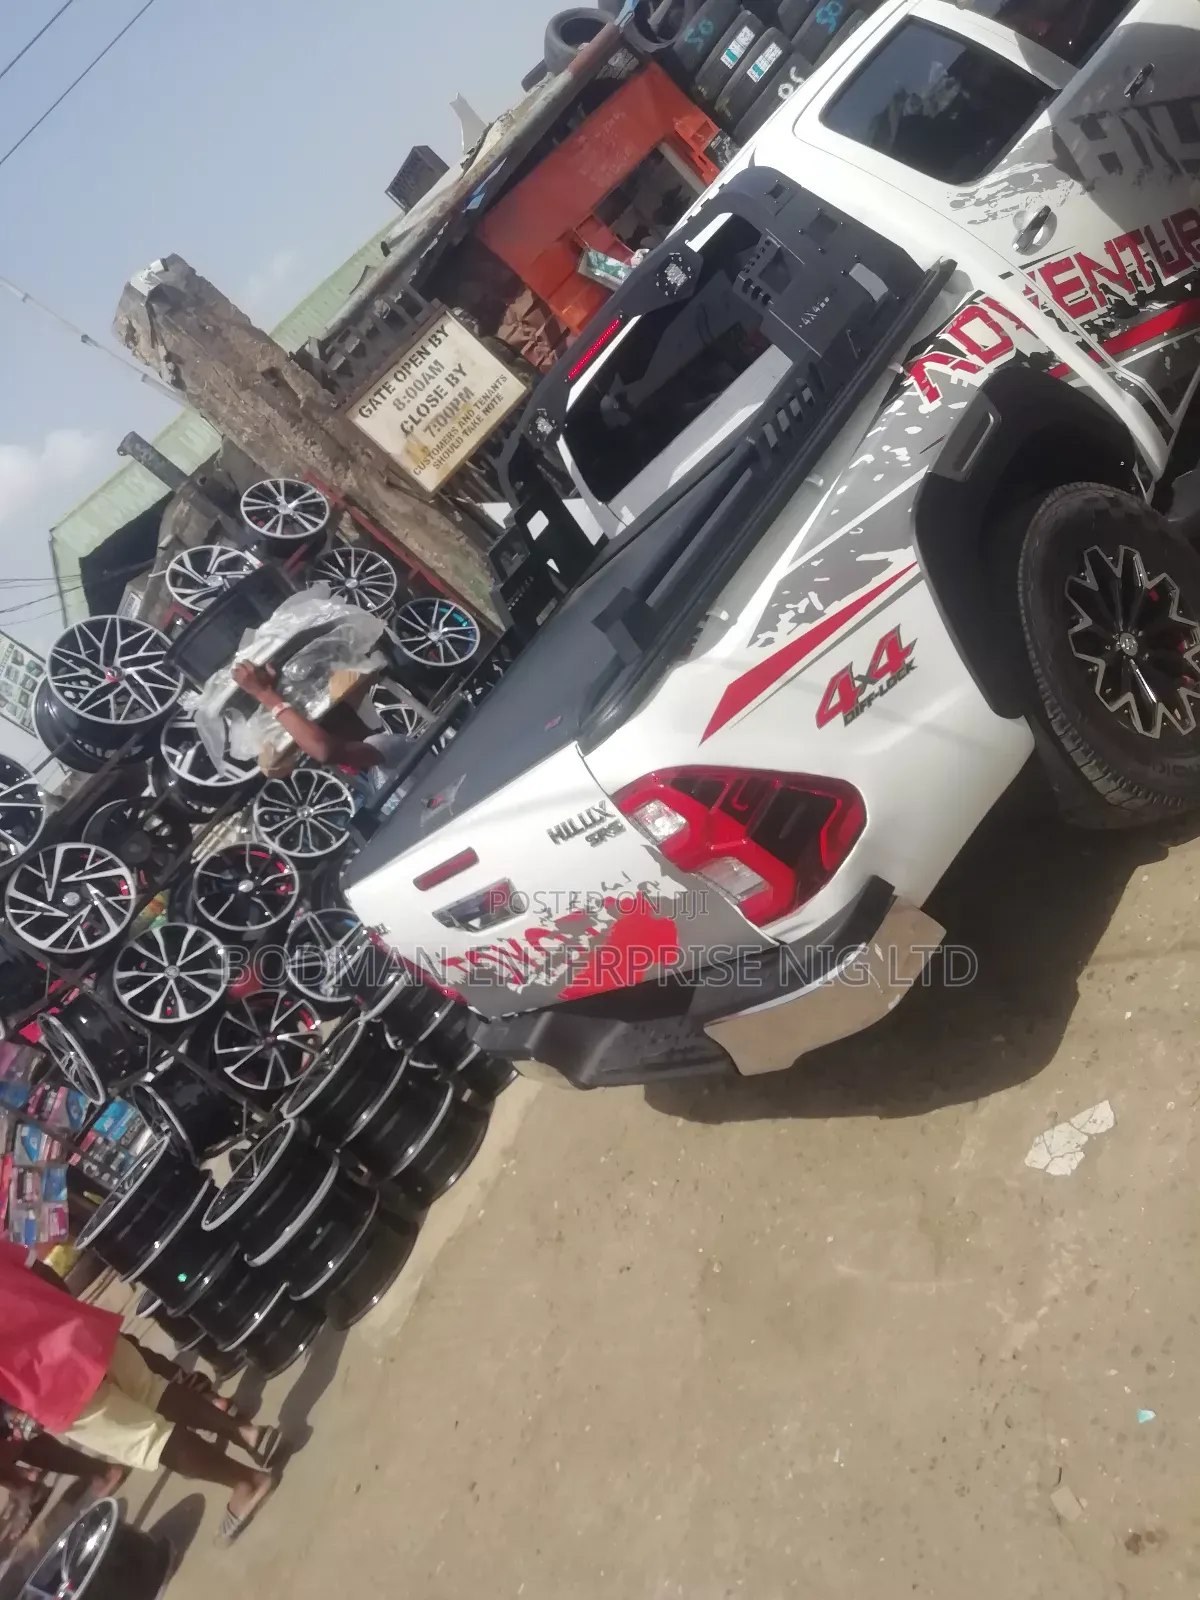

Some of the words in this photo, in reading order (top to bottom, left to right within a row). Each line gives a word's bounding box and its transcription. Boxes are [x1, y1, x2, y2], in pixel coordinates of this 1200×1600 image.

[358, 380, 397, 418] GATE
[393, 345, 432, 383] OPEN
[427, 324, 450, 349] BY
[392, 359, 446, 412] 8:00AM
[400, 384, 449, 436] CLOSE
[444, 362, 468, 388] BY
[413, 426, 459, 476] CUSTOMERS
[458, 409, 476, 429] AND
[472, 374, 509, 410] TENANTS
[422, 386, 475, 438] 7:00PM
[432, 436, 464, 470] SHOULD
[461, 414, 485, 437] TAKE
[481, 392, 505, 417] NOTE
[843, 656, 918, 728] DIFF-LOCK
[545, 799, 616, 846] HILUX
